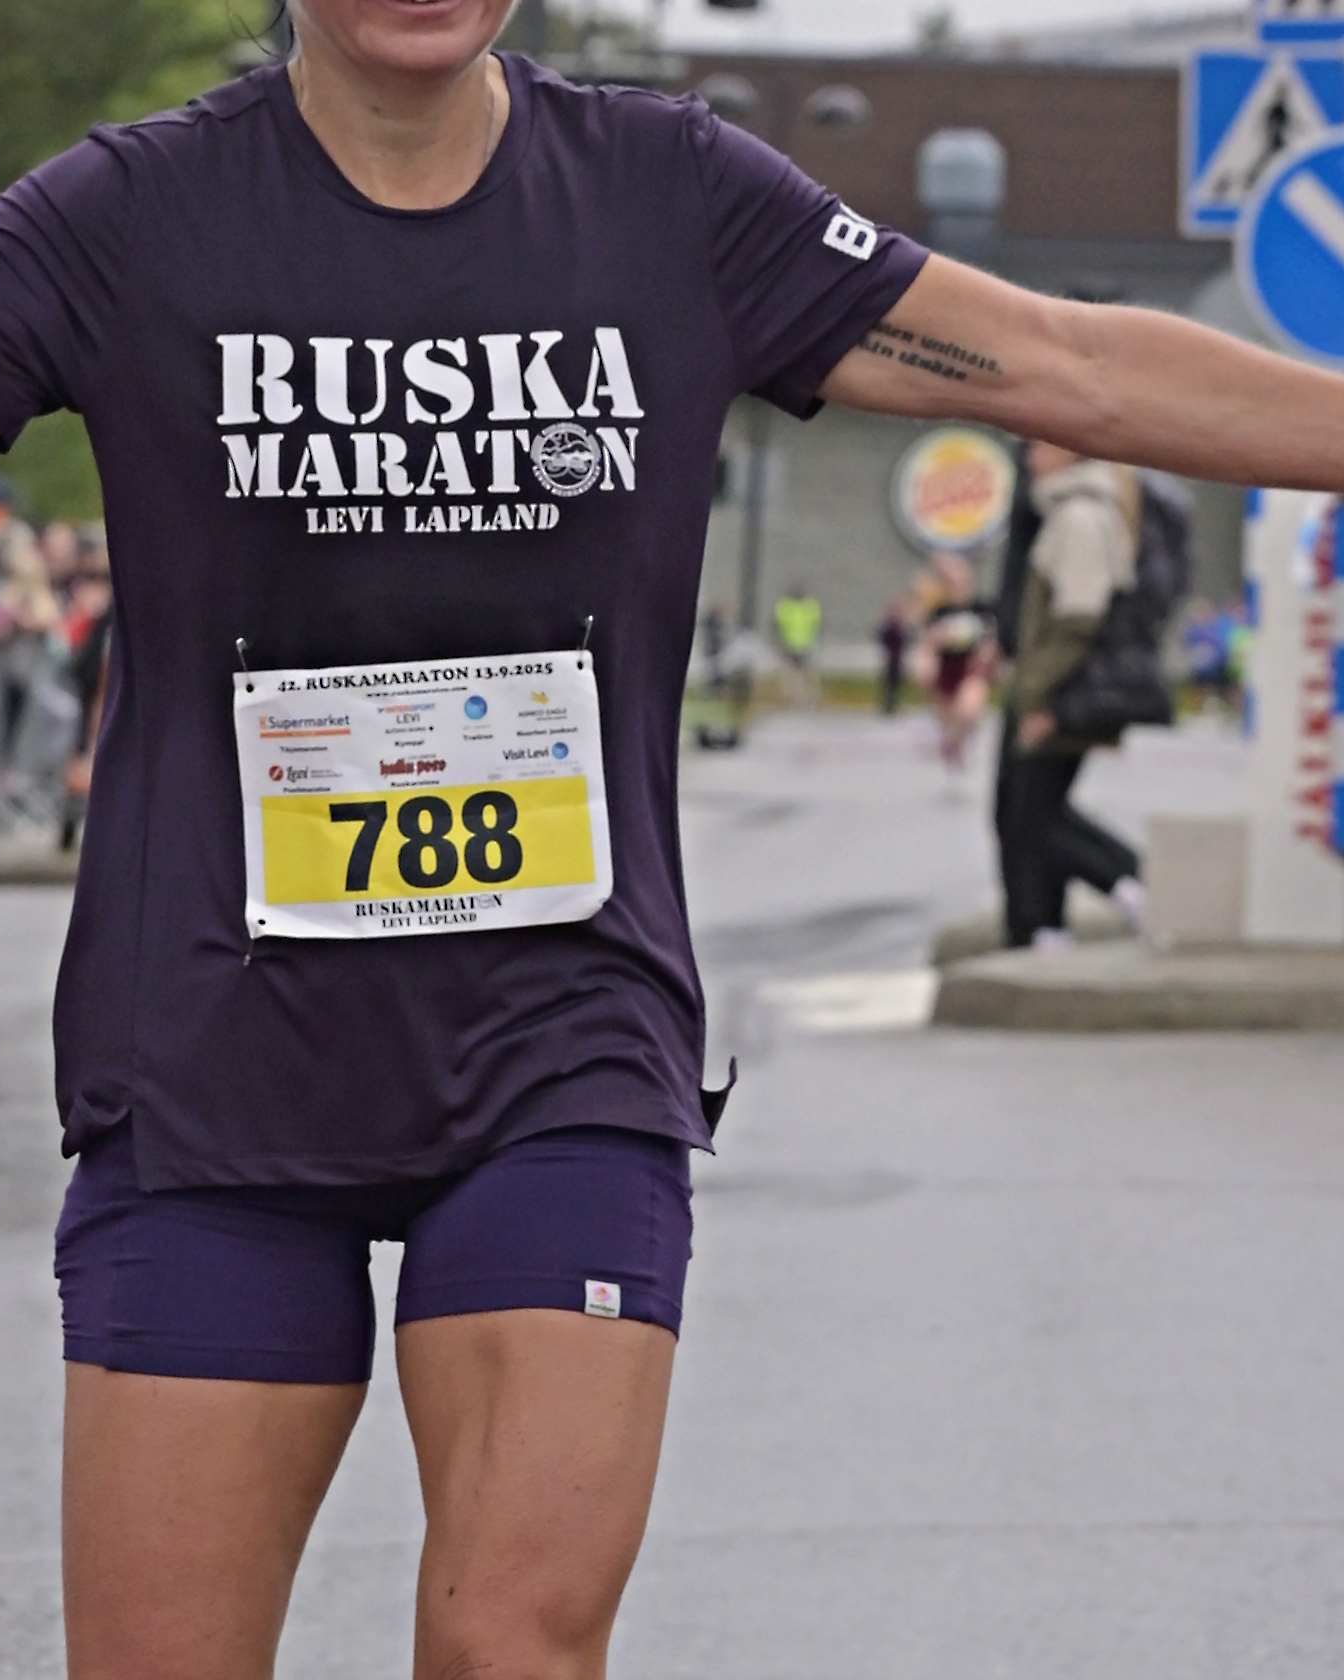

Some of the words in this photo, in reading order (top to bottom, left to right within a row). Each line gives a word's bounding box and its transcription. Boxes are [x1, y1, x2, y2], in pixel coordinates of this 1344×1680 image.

[216, 326, 645, 425] RUSKA
[306, 506, 384, 534] LEVI
[405, 504, 560, 533] LAPLAND
[278, 680, 301, 693] 42.
[305, 667, 469, 691] RUSKAMARATON
[474, 662, 554, 679] 13.9.2025
[268, 715, 350, 731] Supermarket
[396, 713, 421, 724] LEVI
[502, 749, 525, 761] Visit
[527, 748, 549, 760] Levi
[329, 790, 523, 892] 788
[382, 916, 411, 929] LEVI
[418, 913, 477, 926] LAPLAND
